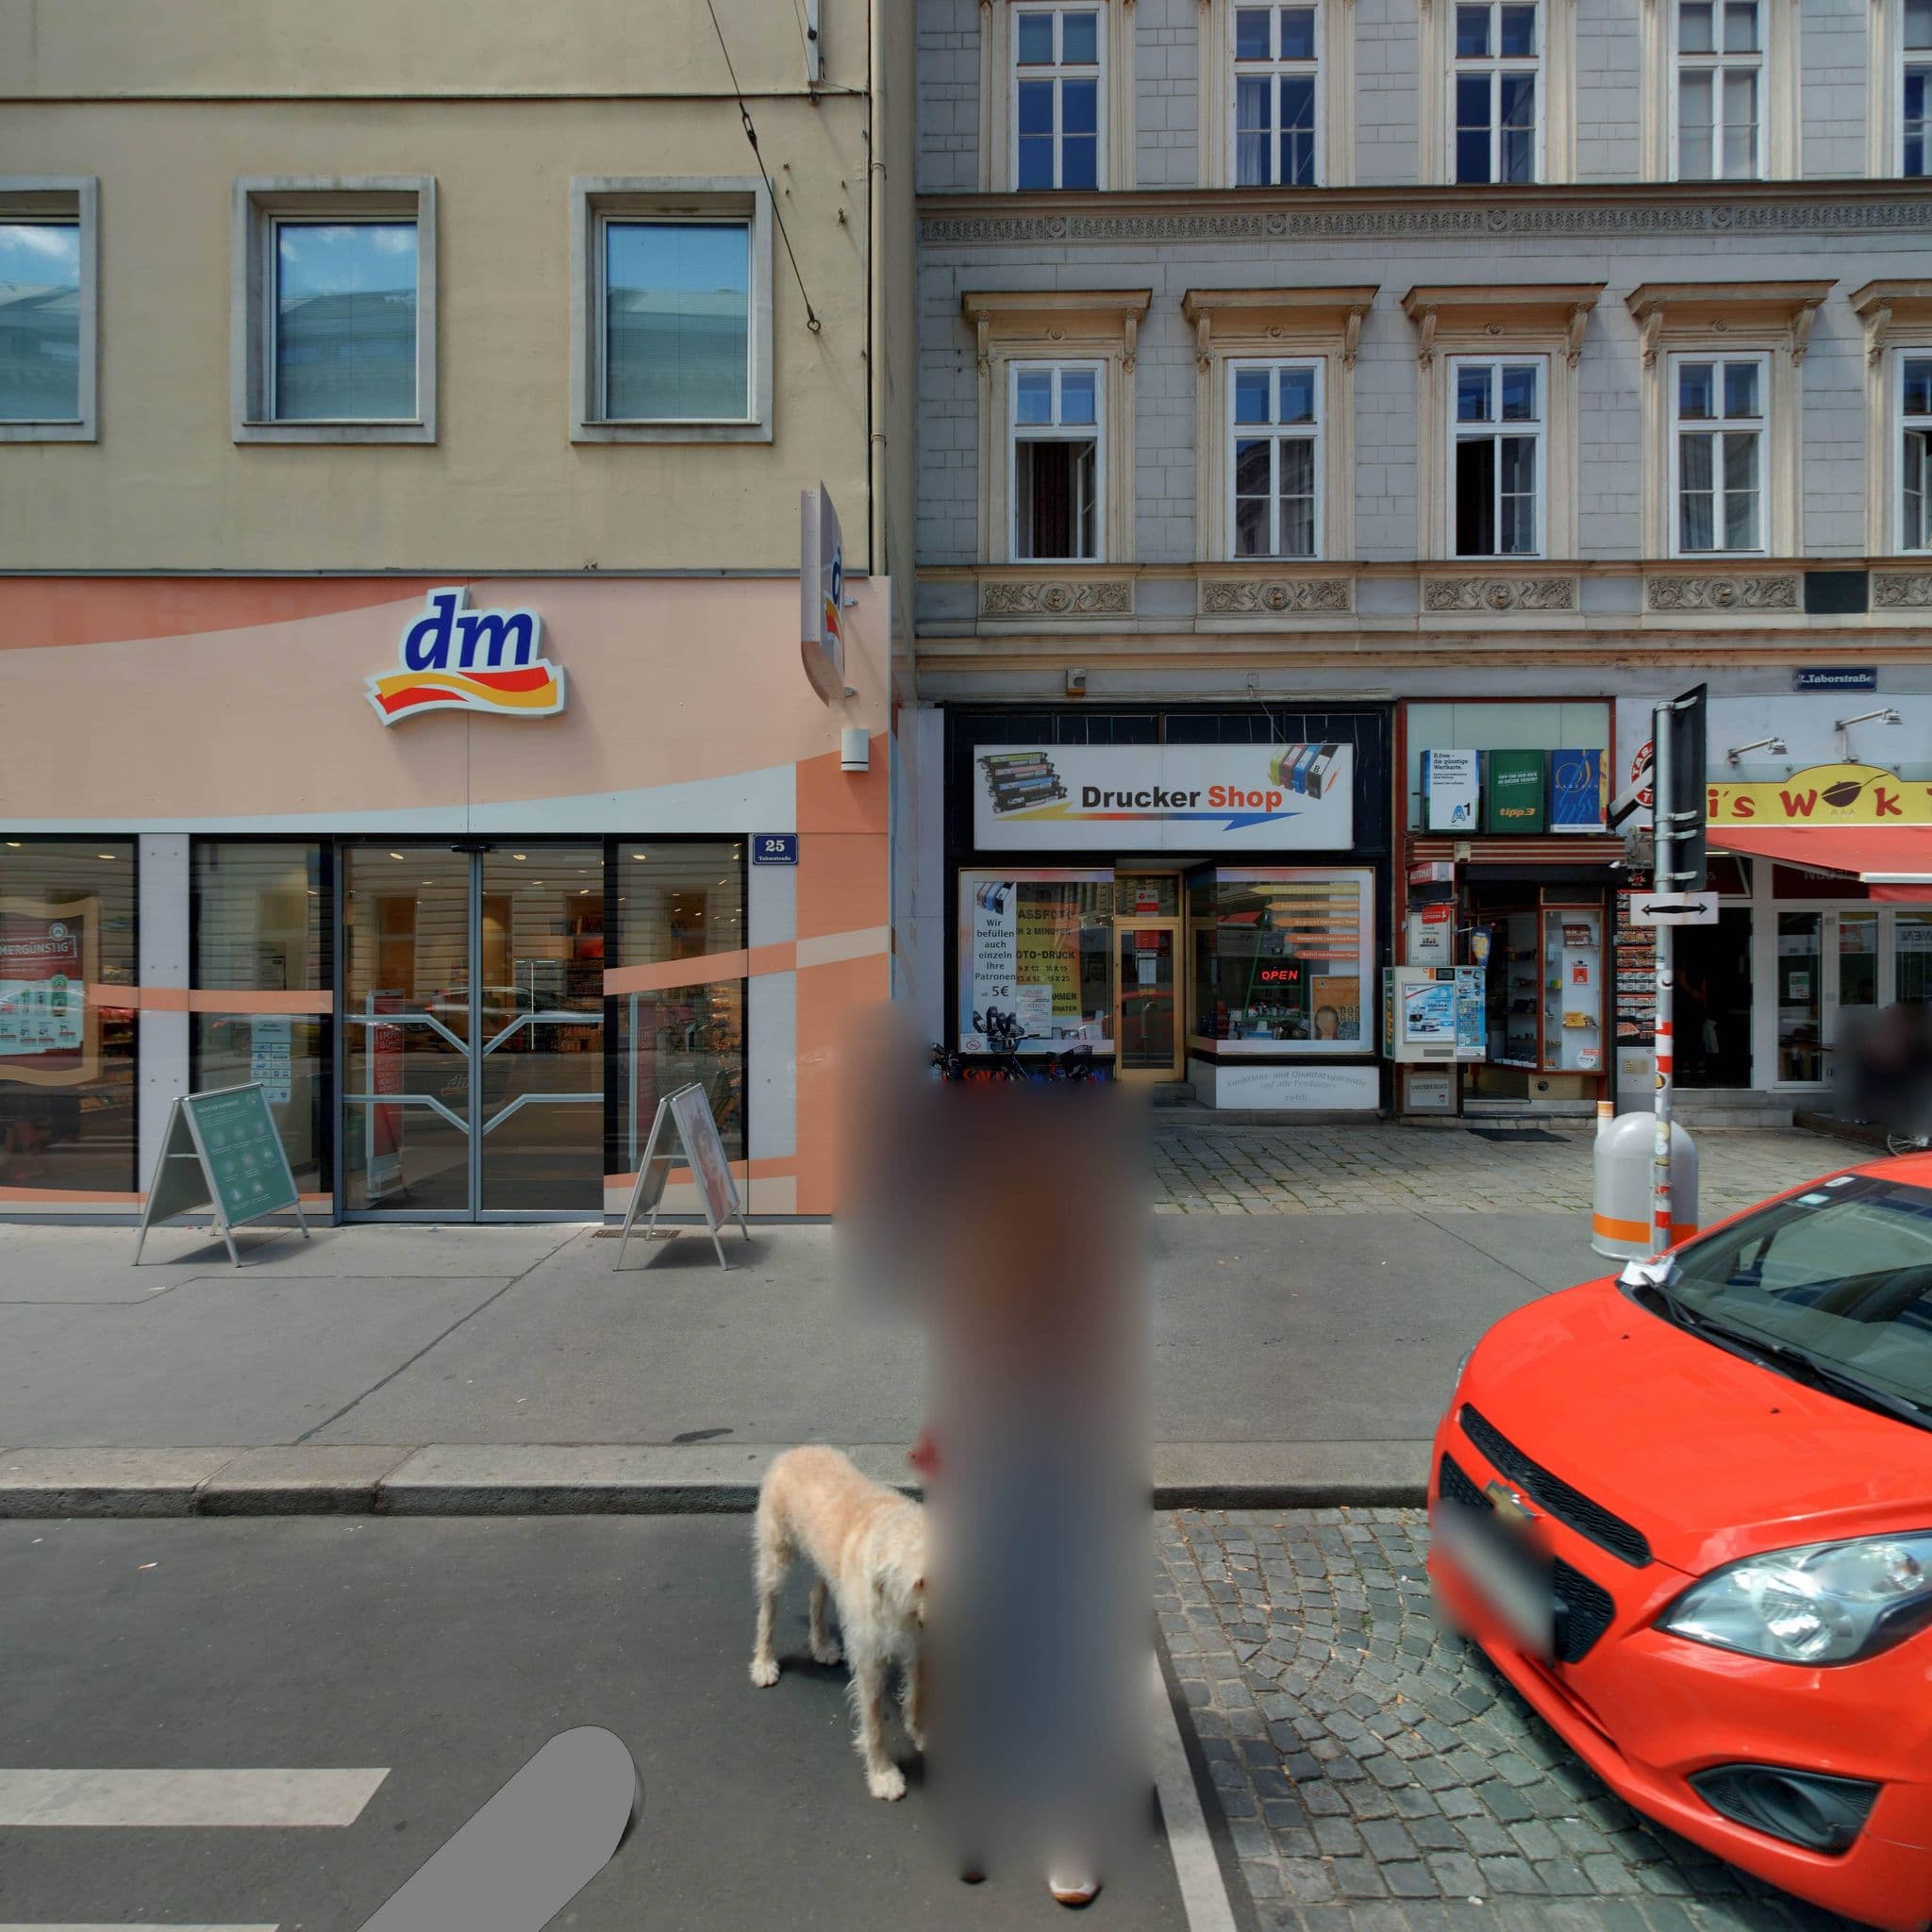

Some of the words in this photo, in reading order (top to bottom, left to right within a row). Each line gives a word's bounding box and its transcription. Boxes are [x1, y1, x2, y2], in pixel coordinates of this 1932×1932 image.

[406, 594, 534, 672] dm
[1082, 786, 1201, 808] Drucker
[1208, 785, 1283, 812] Shop
[1451, 802, 1471, 824] A1
[1500, 808, 1536, 818] tipp3
[766, 839, 785, 852] 25
[1018, 908, 1075, 920] ASSFOTO
[976, 929, 1015, 938] befüllen
[0, 942, 69, 956] MERGÜNSTIG
[984, 941, 1007, 949] auch
[978, 951, 1012, 959] einzeln
[1260, 970, 1298, 981] OPEN
[991, 986, 1009, 997] 5€
